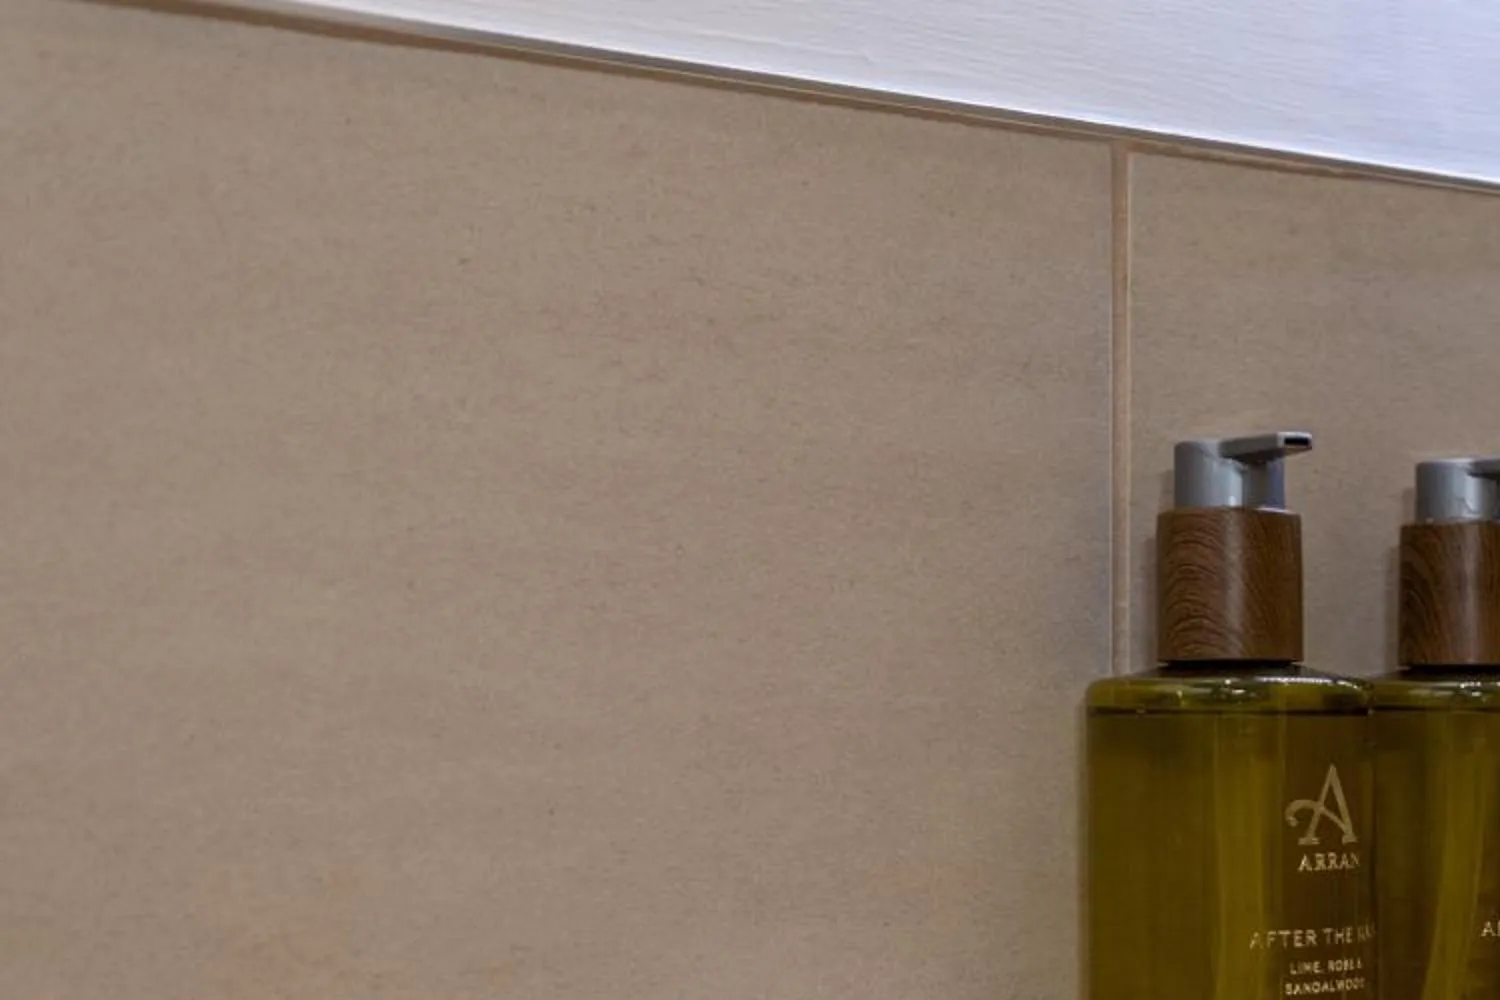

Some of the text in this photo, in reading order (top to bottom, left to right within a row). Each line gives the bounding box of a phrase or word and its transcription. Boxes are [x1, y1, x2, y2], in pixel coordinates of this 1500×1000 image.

[1285, 763, 1359, 845] A
[1249, 929, 1318, 950] AFTER
[1322, 926, 1353, 945] THE
